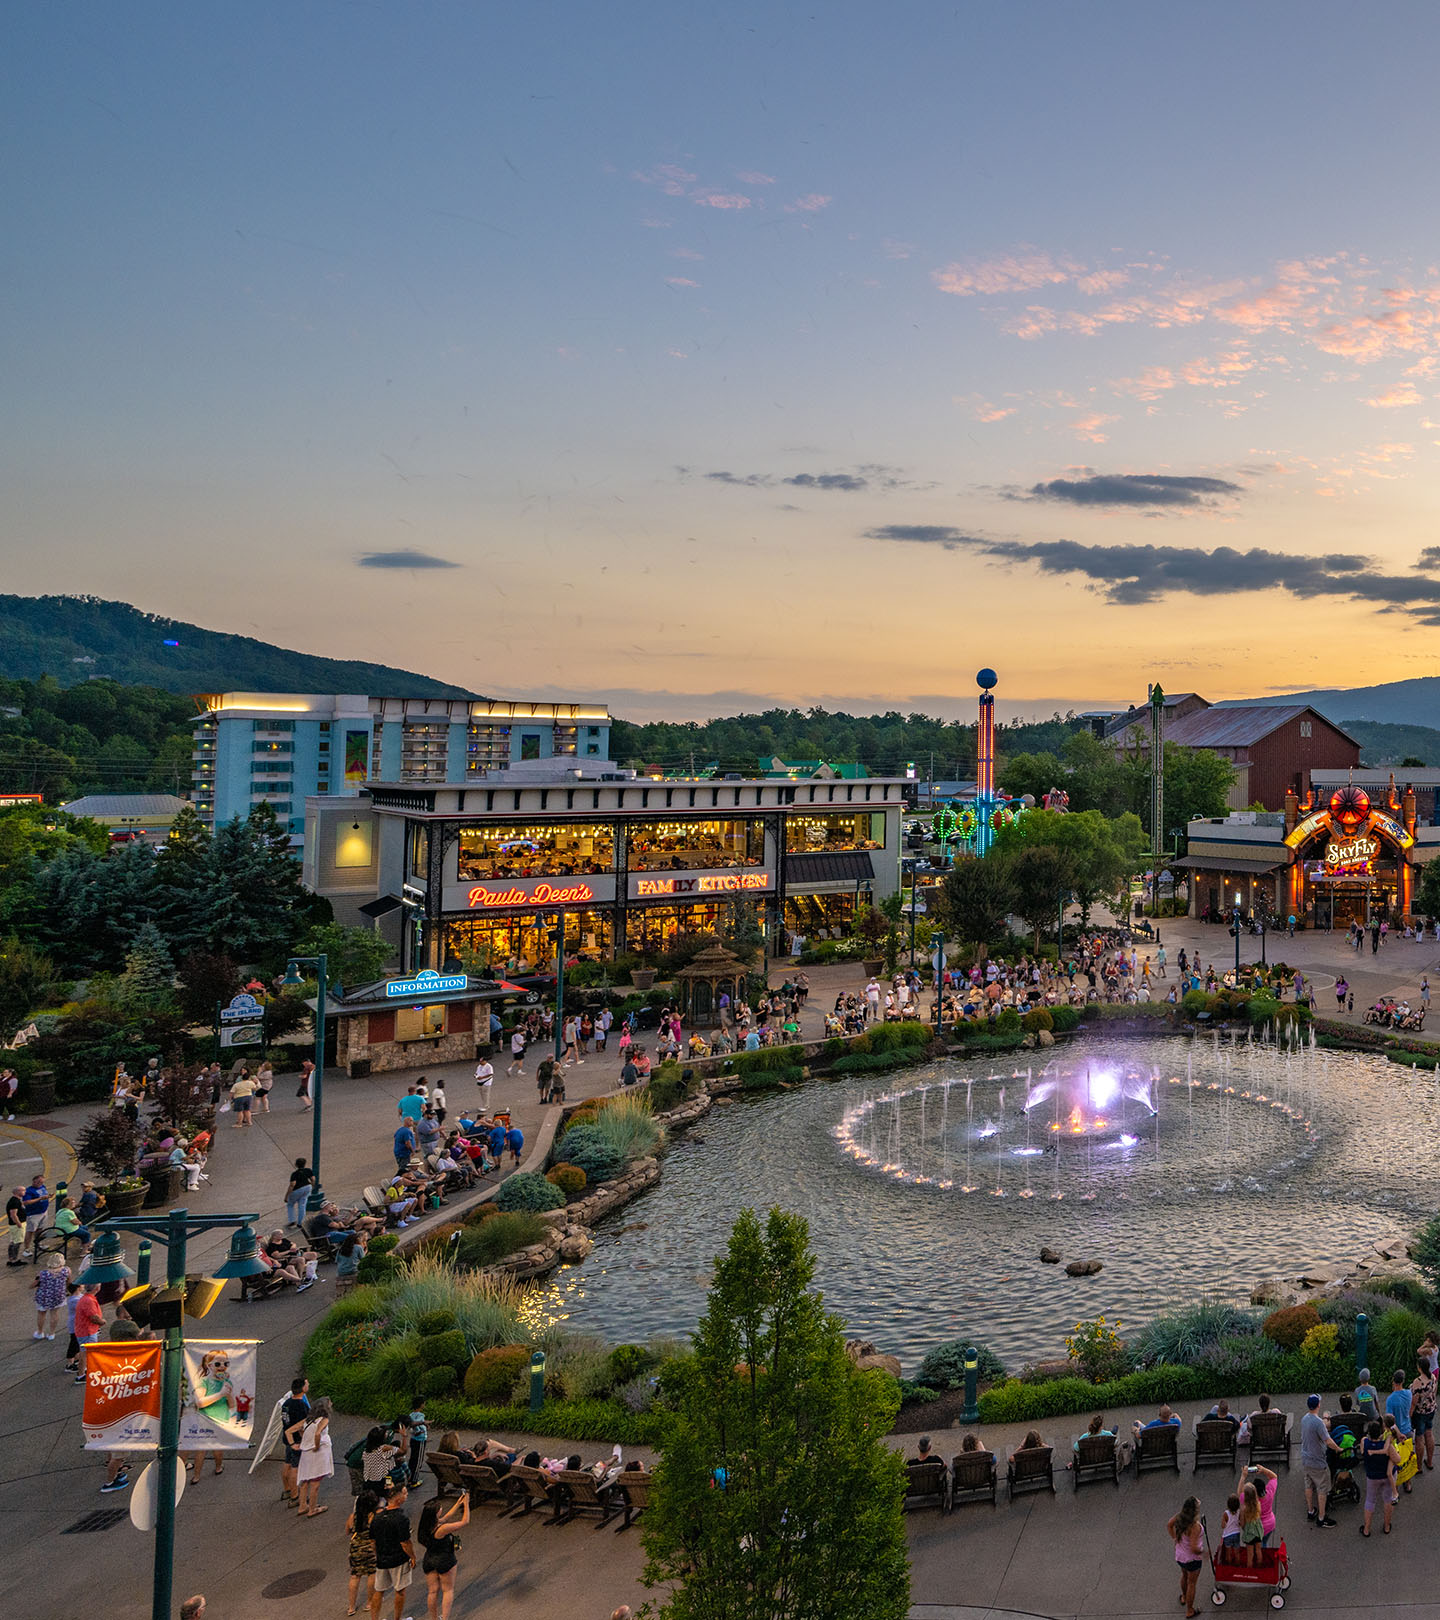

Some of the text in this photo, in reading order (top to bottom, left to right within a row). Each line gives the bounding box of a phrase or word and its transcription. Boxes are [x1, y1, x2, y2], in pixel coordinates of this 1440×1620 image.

[637, 874, 768, 895] FAMILY KITCHEN
[469, 883, 593, 907] Paula Deen's
[390, 979, 464, 993] INFORMATION
[89, 1367, 156, 1387] Summer
[104, 1383, 150, 1401] Vibes
